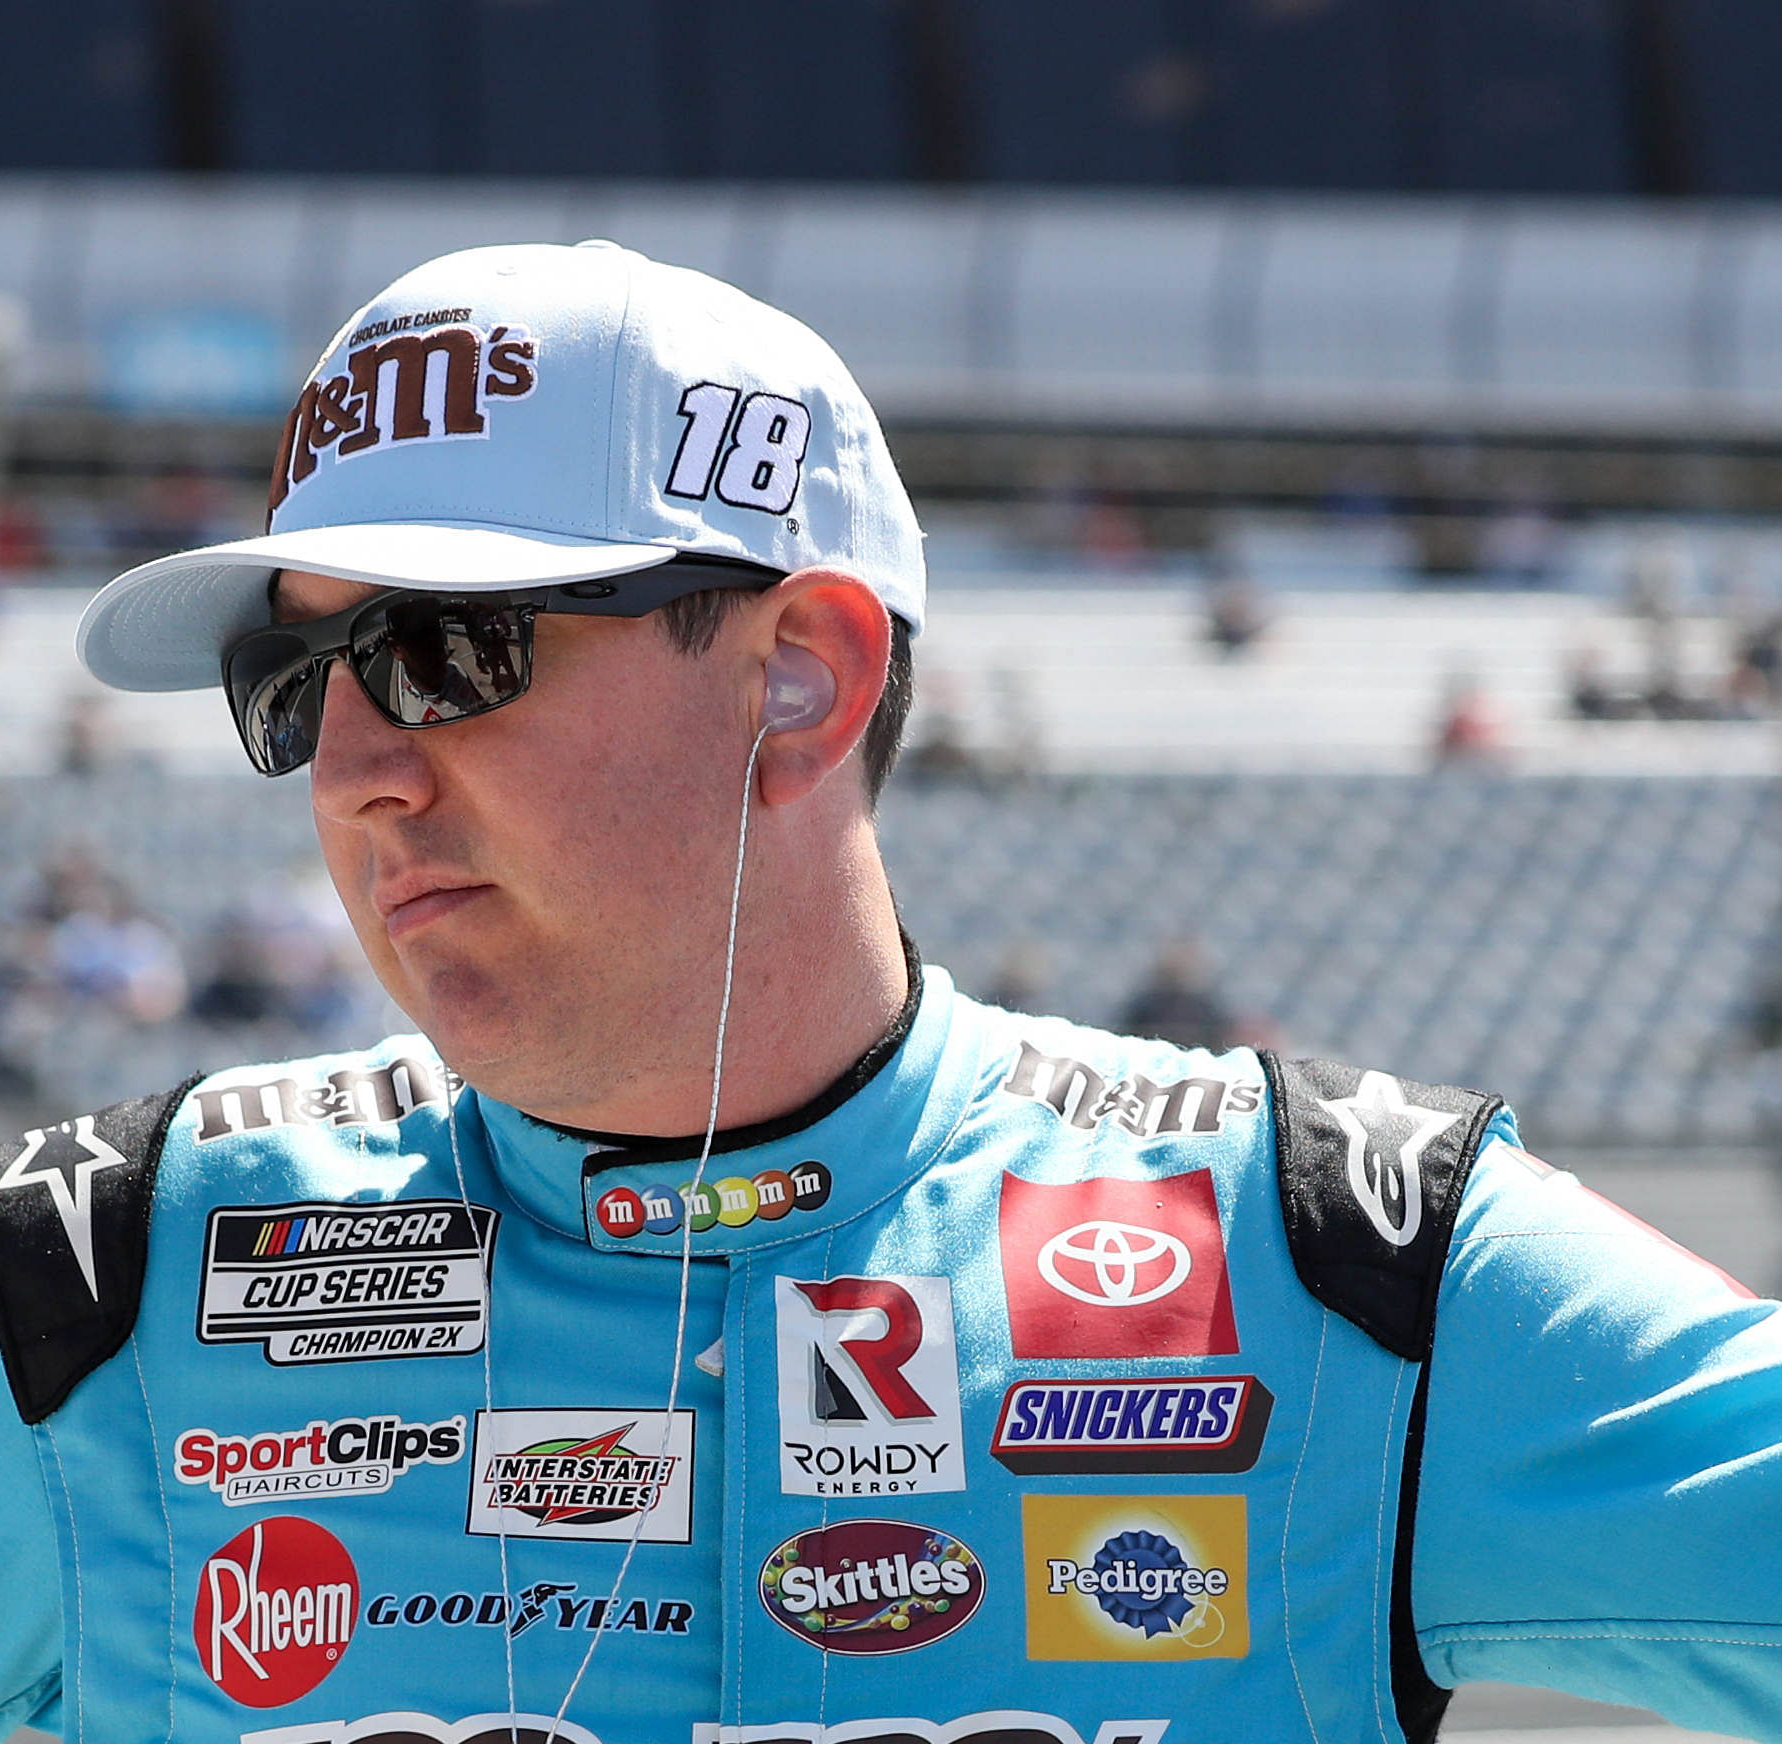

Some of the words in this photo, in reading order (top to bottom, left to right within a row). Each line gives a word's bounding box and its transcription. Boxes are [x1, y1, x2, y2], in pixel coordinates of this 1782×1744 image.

[349, 315, 411, 348] CHOCOLATE
[414, 307, 472, 331] CANDIES
[664, 381, 812, 516] 18
[297, 1211, 453, 1253] NASCAR
[242, 1273, 319, 1309] CUP
[319, 1264, 450, 1305] SERIES
[288, 1327, 425, 1357] CHAMPION
[429, 1325, 465, 1349] 2X
[1006, 1386, 1232, 1441] SNICKERS
[179, 1420, 461, 1486] SportClips
[491, 1455, 670, 1484] INTERSTATE
[784, 1441, 950, 1476] ROWDY
[233, 1467, 384, 1498] HAIRCUTS
[495, 1482, 655, 1508] BATTERIES
[817, 1480, 918, 1494] ENERGY
[779, 1555, 971, 1614] Skittles
[1046, 1558, 1229, 1601] Pedigree
[207, 1523, 353, 1682] Rheem
